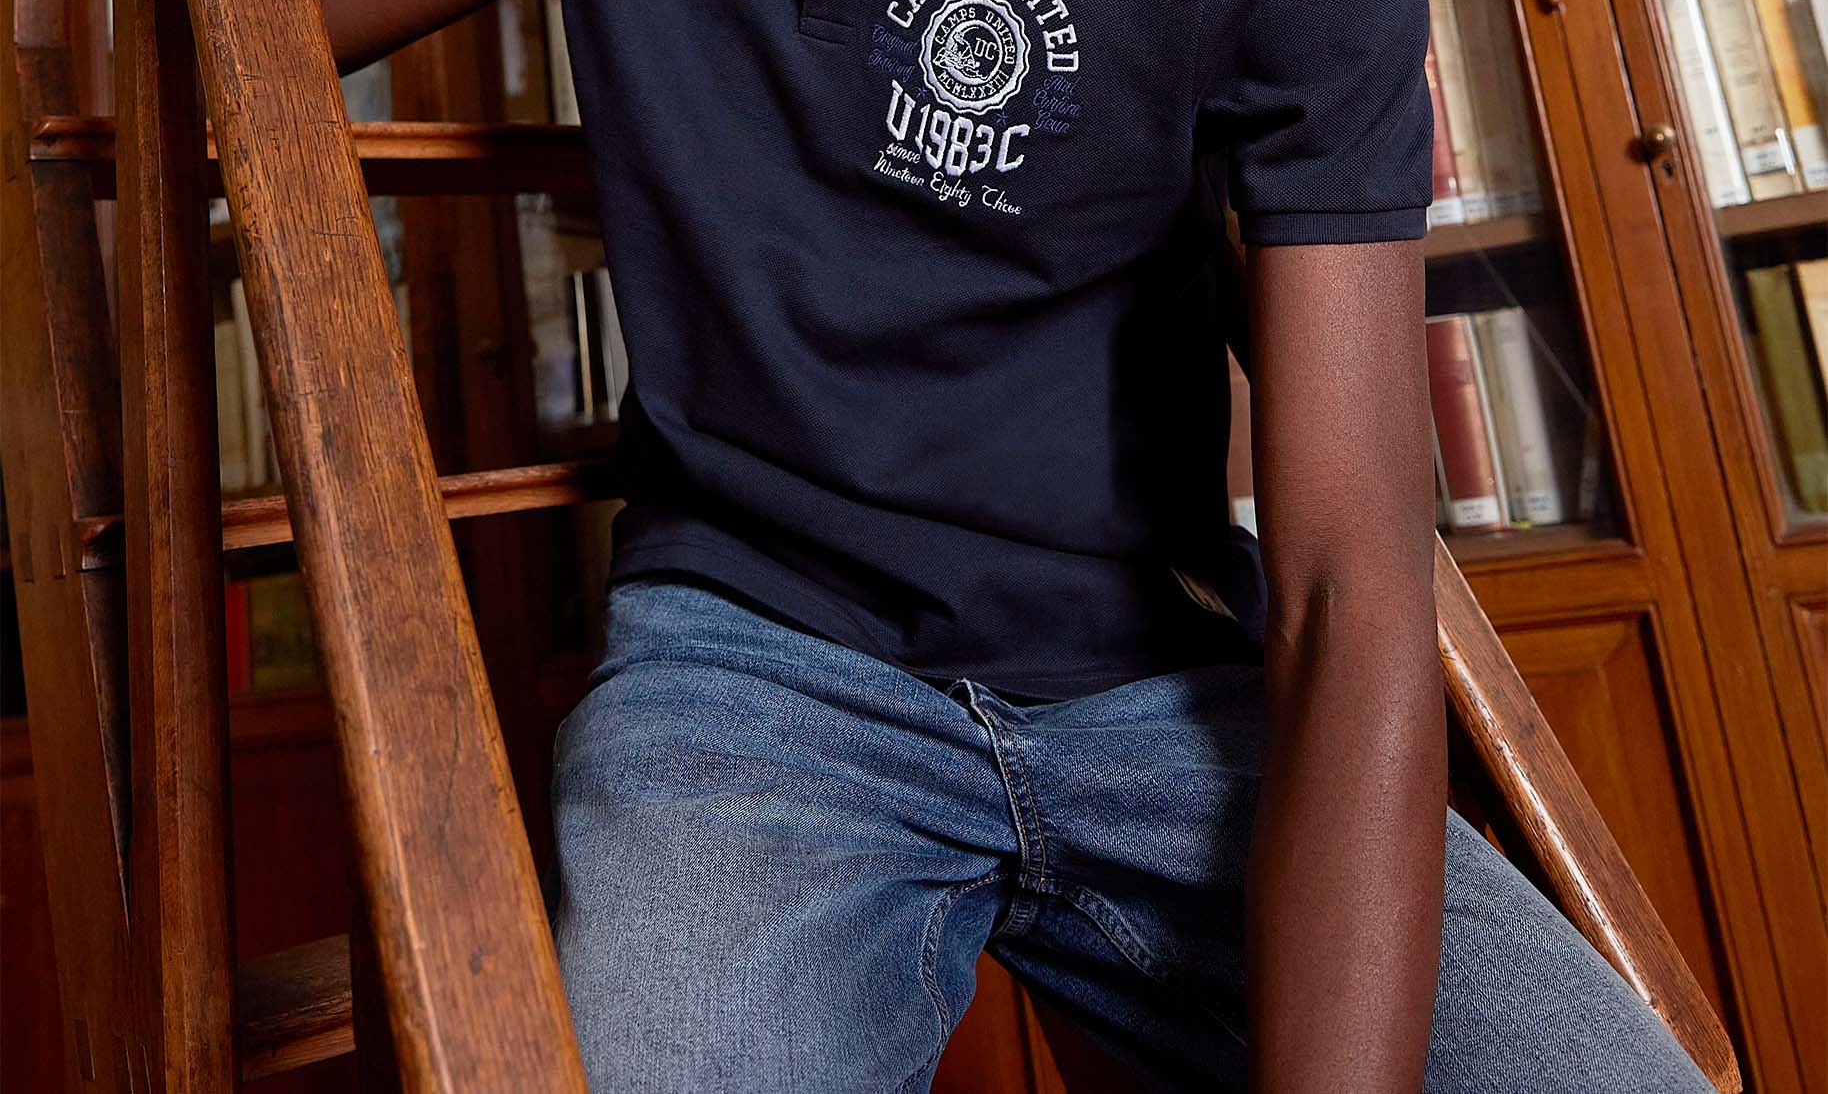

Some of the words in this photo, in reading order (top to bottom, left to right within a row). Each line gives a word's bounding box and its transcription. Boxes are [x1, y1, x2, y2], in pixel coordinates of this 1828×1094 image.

[935, 7, 976, 45] CAMPS
[985, 10, 1016, 64] UNITED
[974, 37, 998, 61] UC
[873, 150, 925, 187] Nineteen
[930, 171, 972, 207] Eighty
